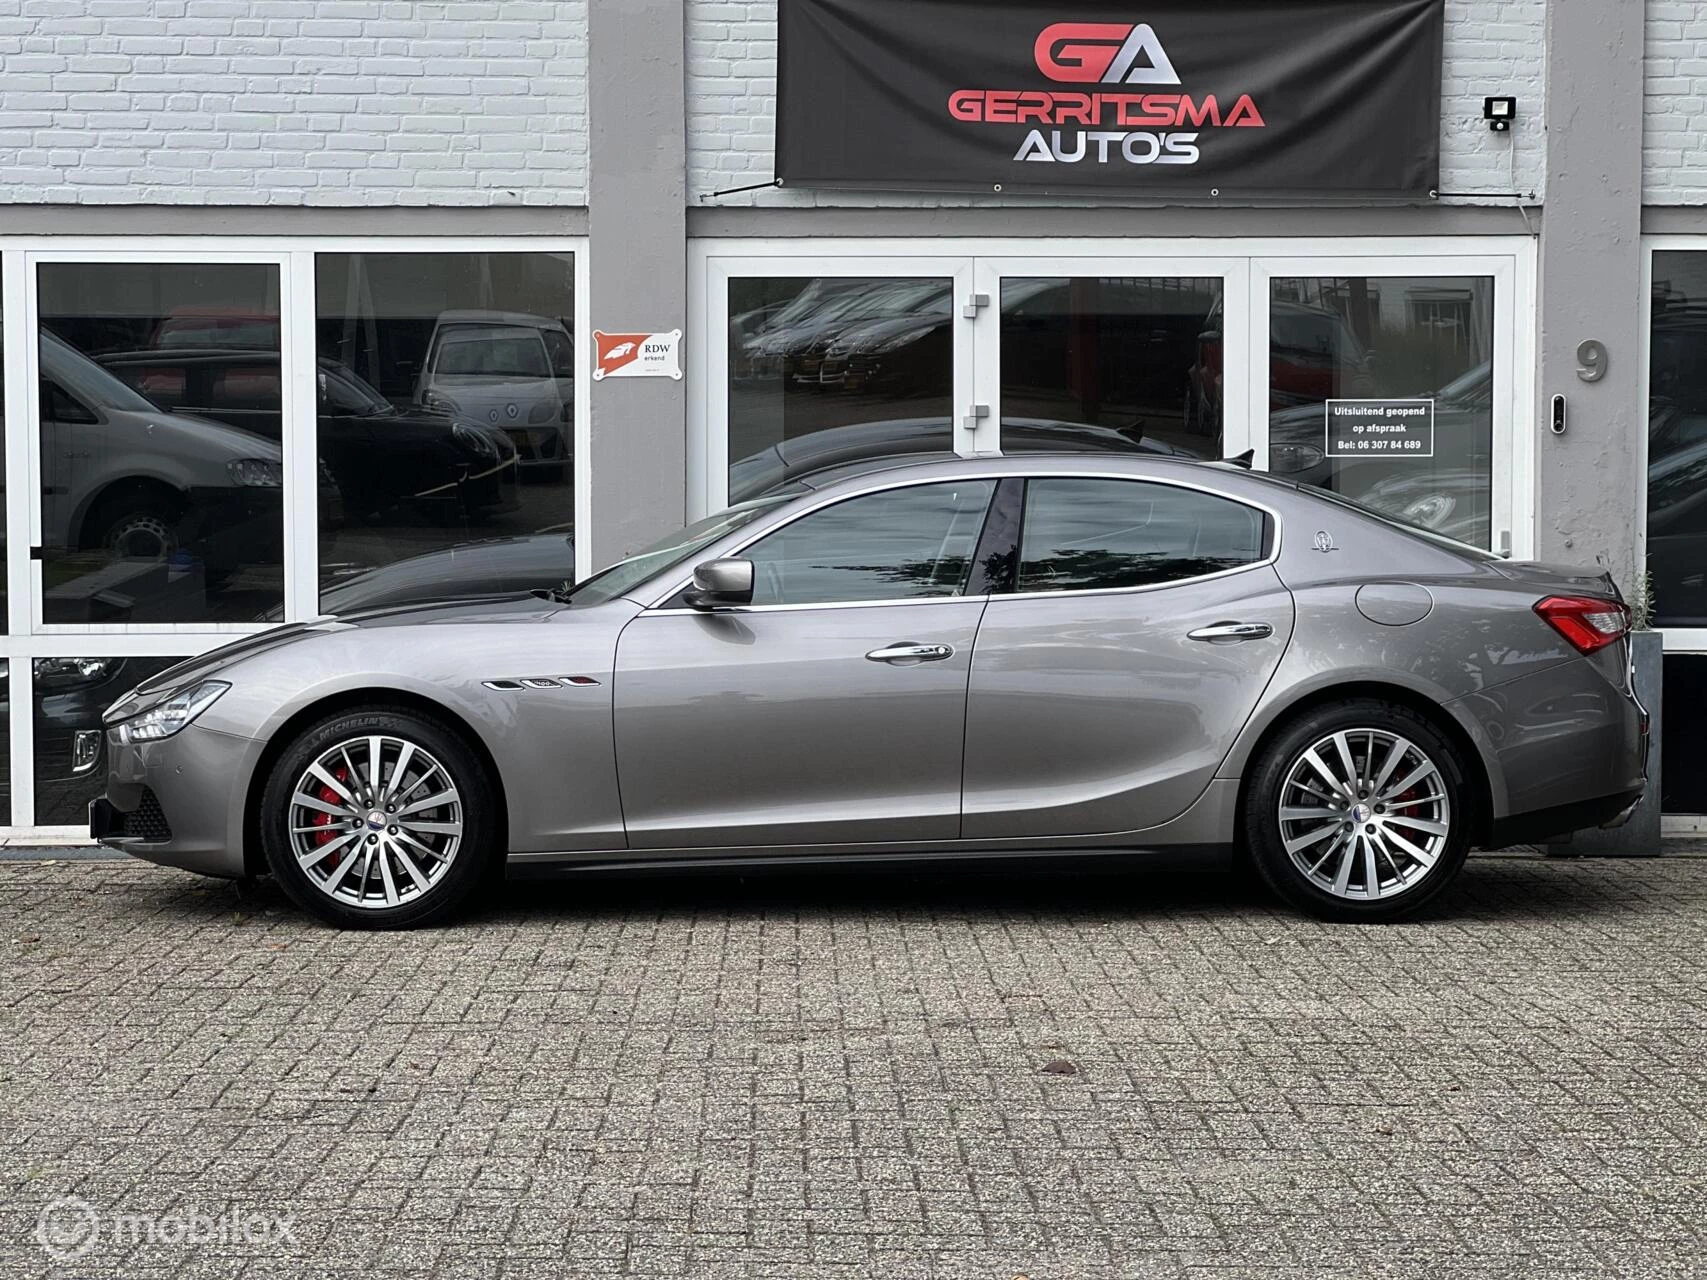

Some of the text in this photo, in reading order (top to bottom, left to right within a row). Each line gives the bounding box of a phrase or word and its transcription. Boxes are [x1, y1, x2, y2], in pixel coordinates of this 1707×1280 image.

[1034, 22, 1181, 85] GA
[948, 90, 1266, 127] GERRITSMA
[1013, 129, 1200, 164] AUTO'S
[644, 344, 671, 353] RDW
[1576, 338, 1608, 382] 9
[1334, 407, 1425, 417] Uitsluitend geopend
[1352, 424, 1407, 434] op afspraak
[1338, 441, 1421, 449] Bel: 06 307 84 689
[319, 717, 378, 741] MICHELIN
